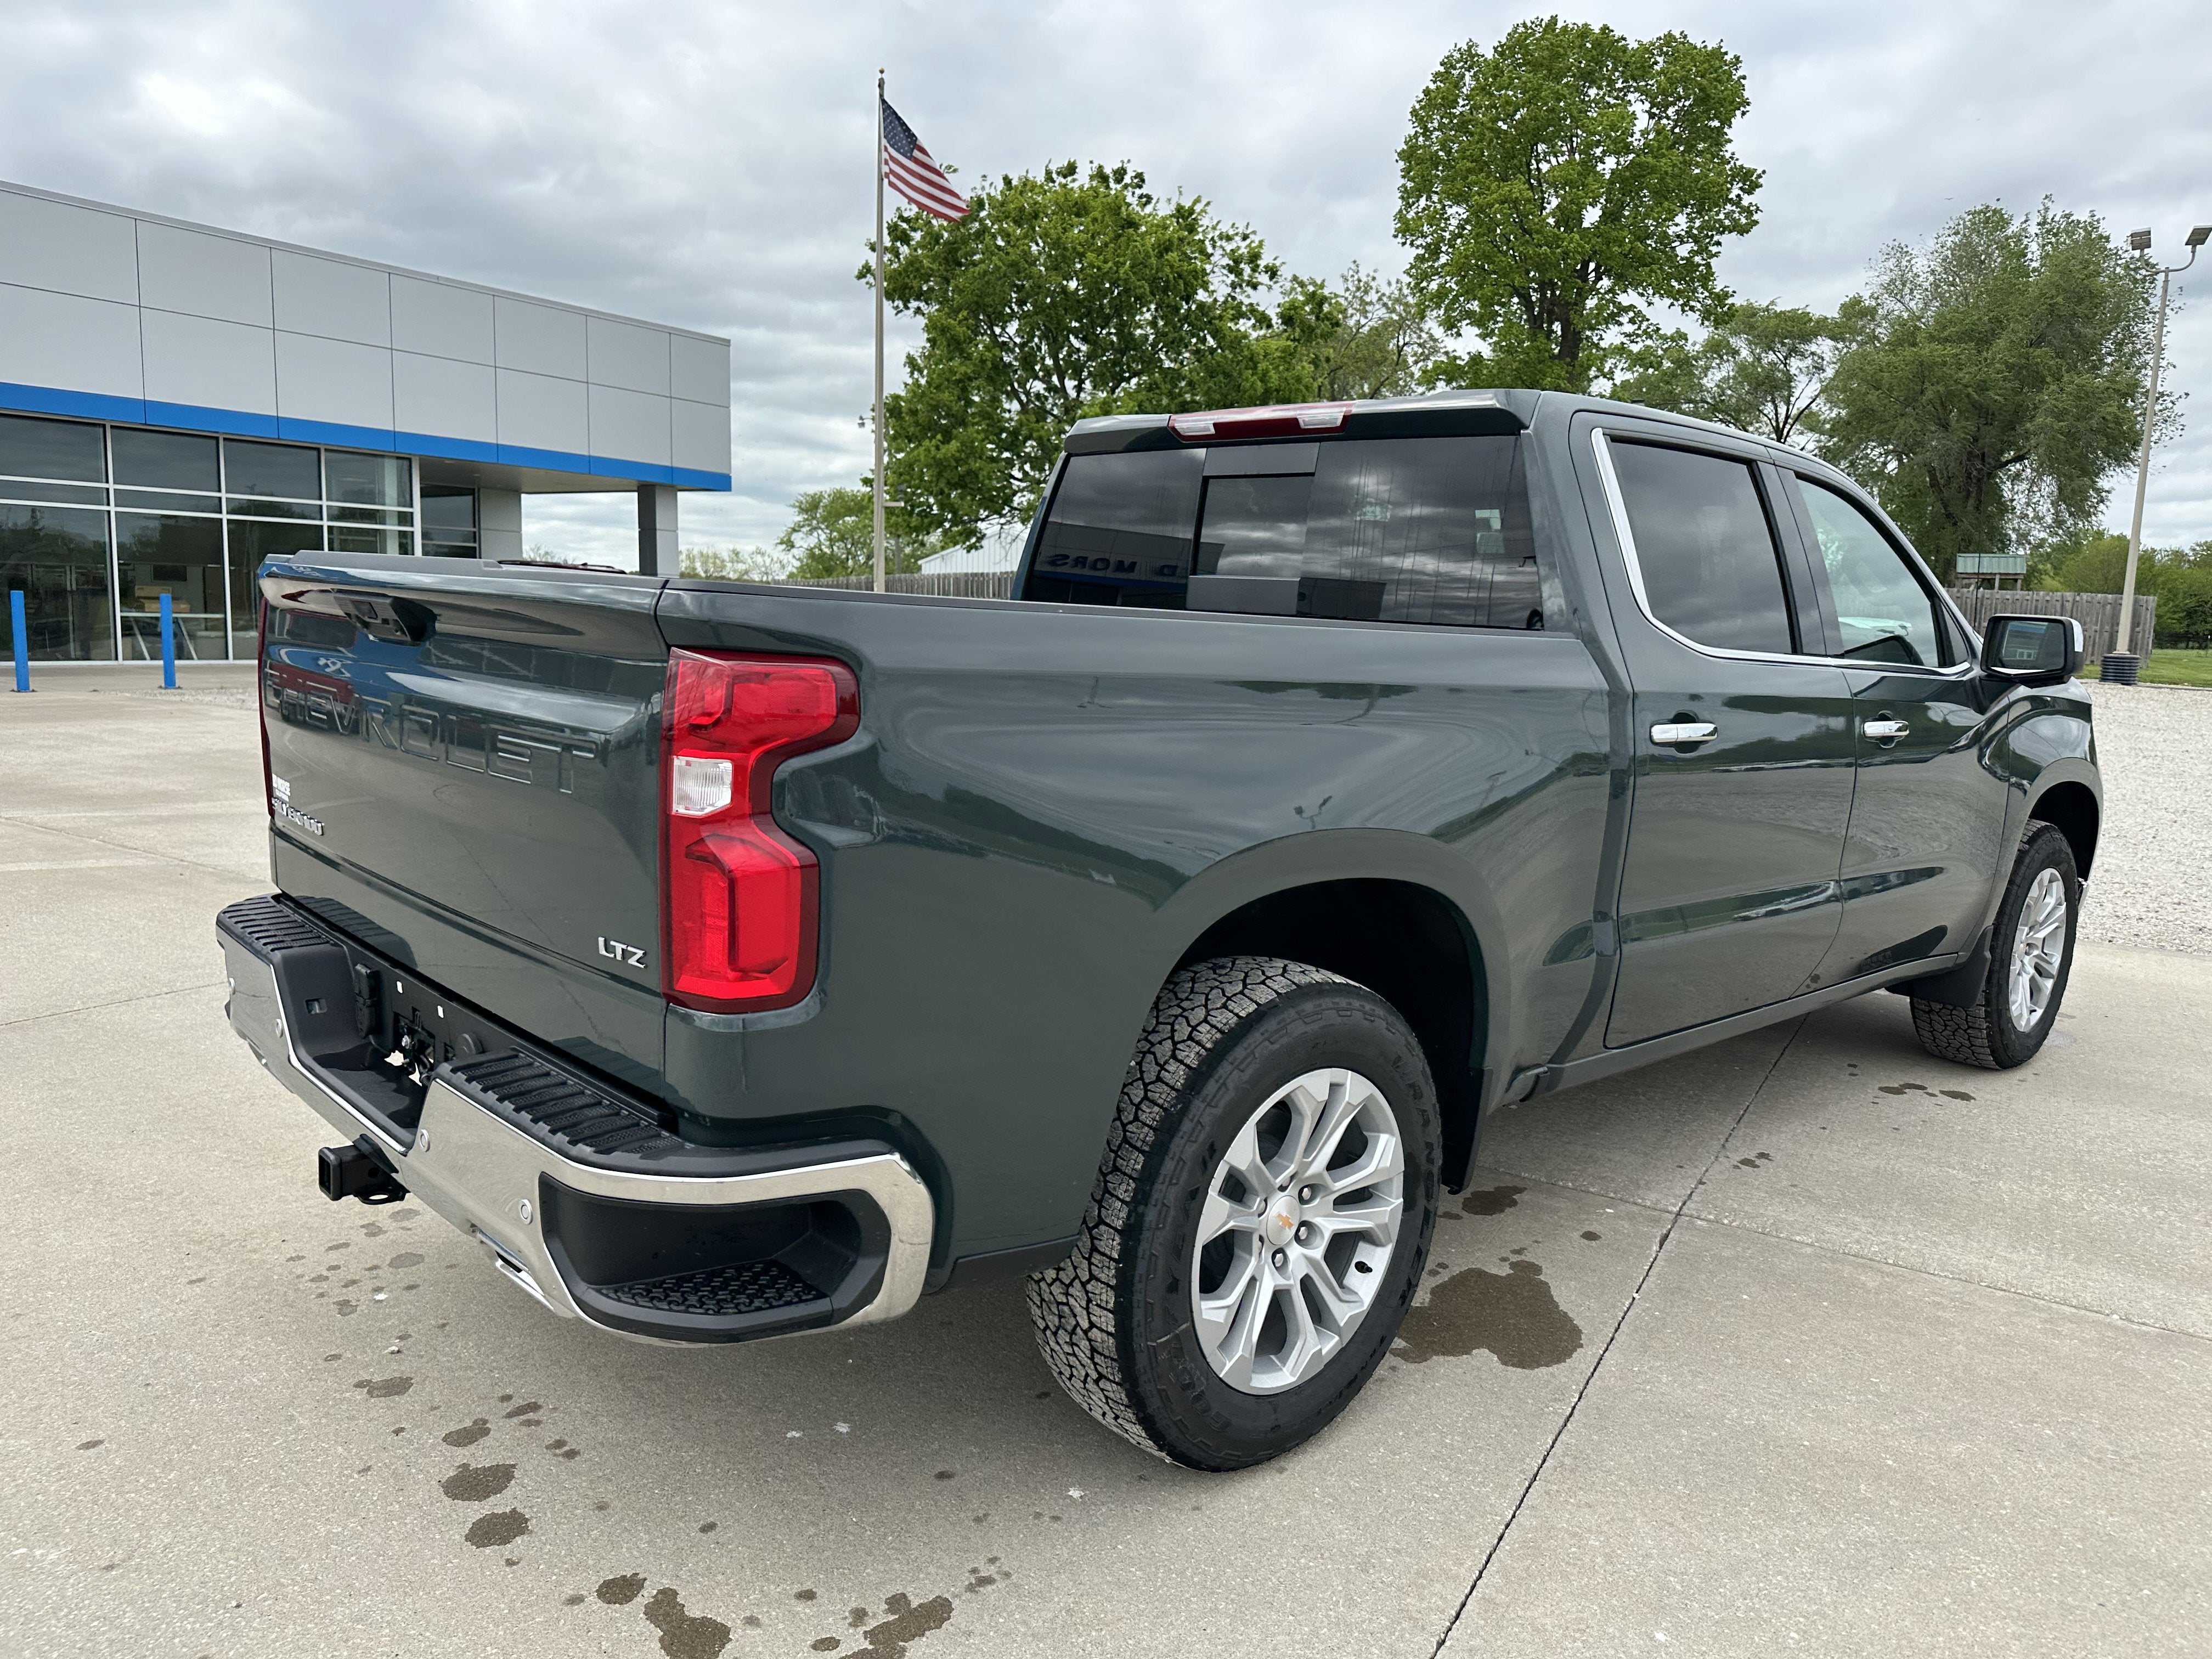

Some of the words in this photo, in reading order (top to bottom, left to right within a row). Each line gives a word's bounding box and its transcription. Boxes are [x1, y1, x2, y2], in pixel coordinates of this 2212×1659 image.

[263, 659, 597, 796] CHEVROLET
[598, 936, 646, 968] LTZ
[1391, 1053, 1435, 1307] WRANGLER
